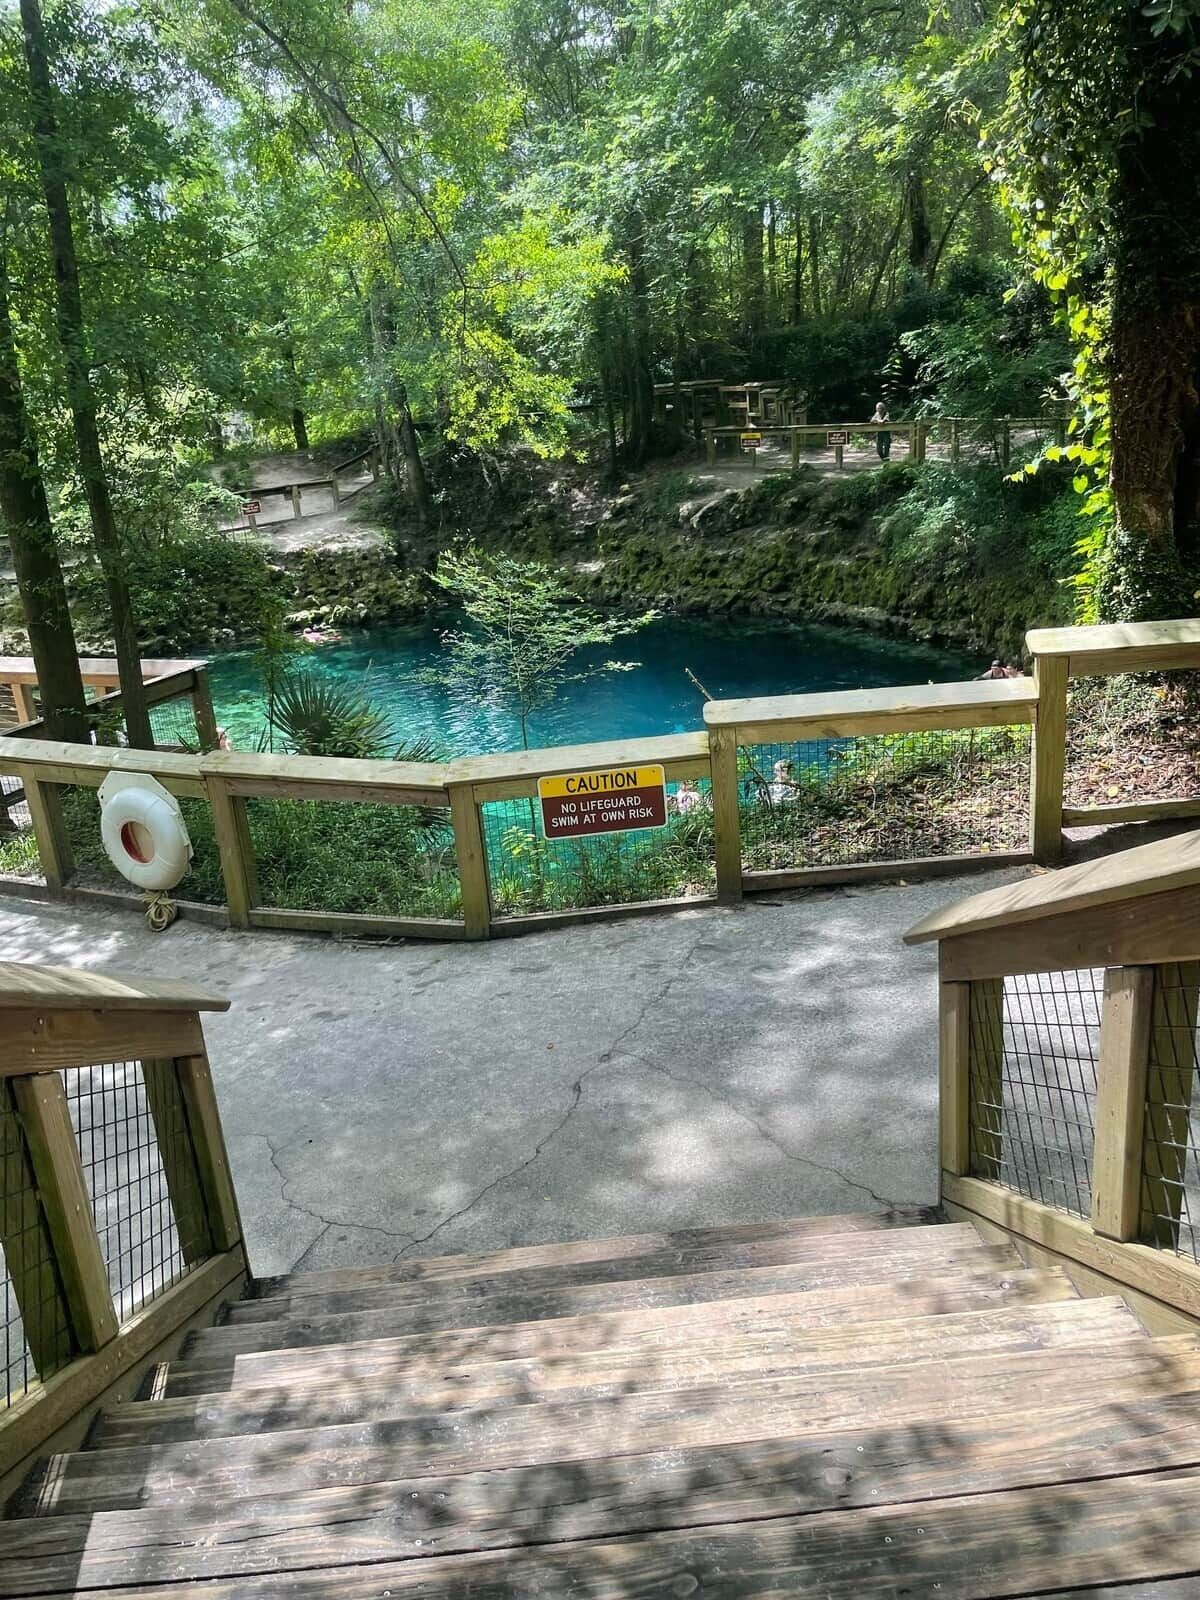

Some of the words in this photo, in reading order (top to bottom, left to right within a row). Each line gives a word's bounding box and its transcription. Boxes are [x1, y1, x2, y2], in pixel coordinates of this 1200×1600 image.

[566, 771, 637, 793] CAUTION
[561, 803, 576, 814] NO
[580, 796, 641, 812] LIFEGUARD
[551, 815, 579, 828] SWIM
[583, 813, 597, 824] AT
[601, 811, 625, 823] OWN
[629, 807, 653, 819] RISK
